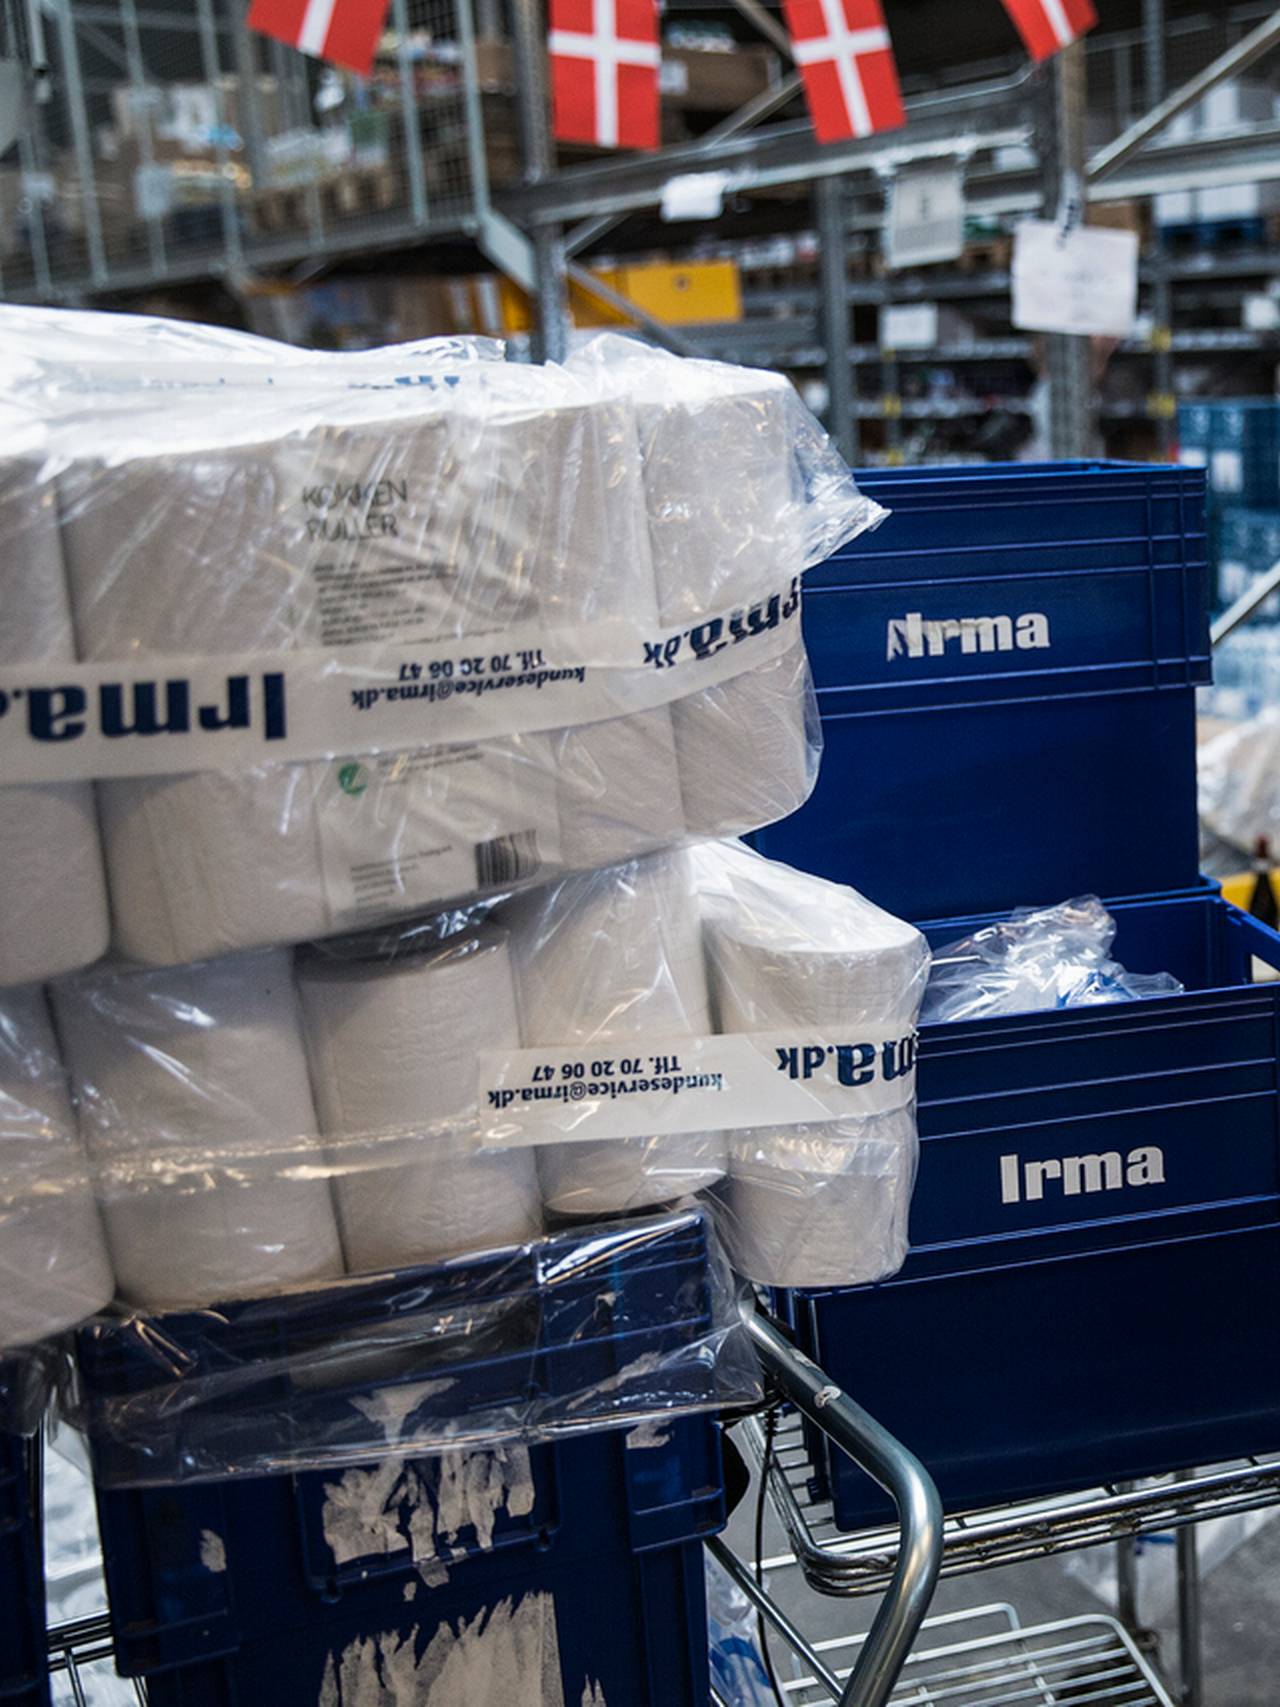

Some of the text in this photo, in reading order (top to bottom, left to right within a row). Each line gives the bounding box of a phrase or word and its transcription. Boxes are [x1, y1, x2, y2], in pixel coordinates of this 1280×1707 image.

[643, 577, 799, 669] rma.dk
[905, 612, 1050, 658] Irma
[399, 663, 423, 682] 47
[429, 660, 453, 679] 06
[491, 652, 513, 672] 70
[0, 672, 286, 743] Irma.
[351, 666, 585, 710] kundeservice@irma.dk
[532, 1056, 682, 1082] Tlf. 70 20 06 47
[488, 1073, 722, 1109] kundeservice@irma.dk
[1000, 1146, 1166, 1204] Irma
